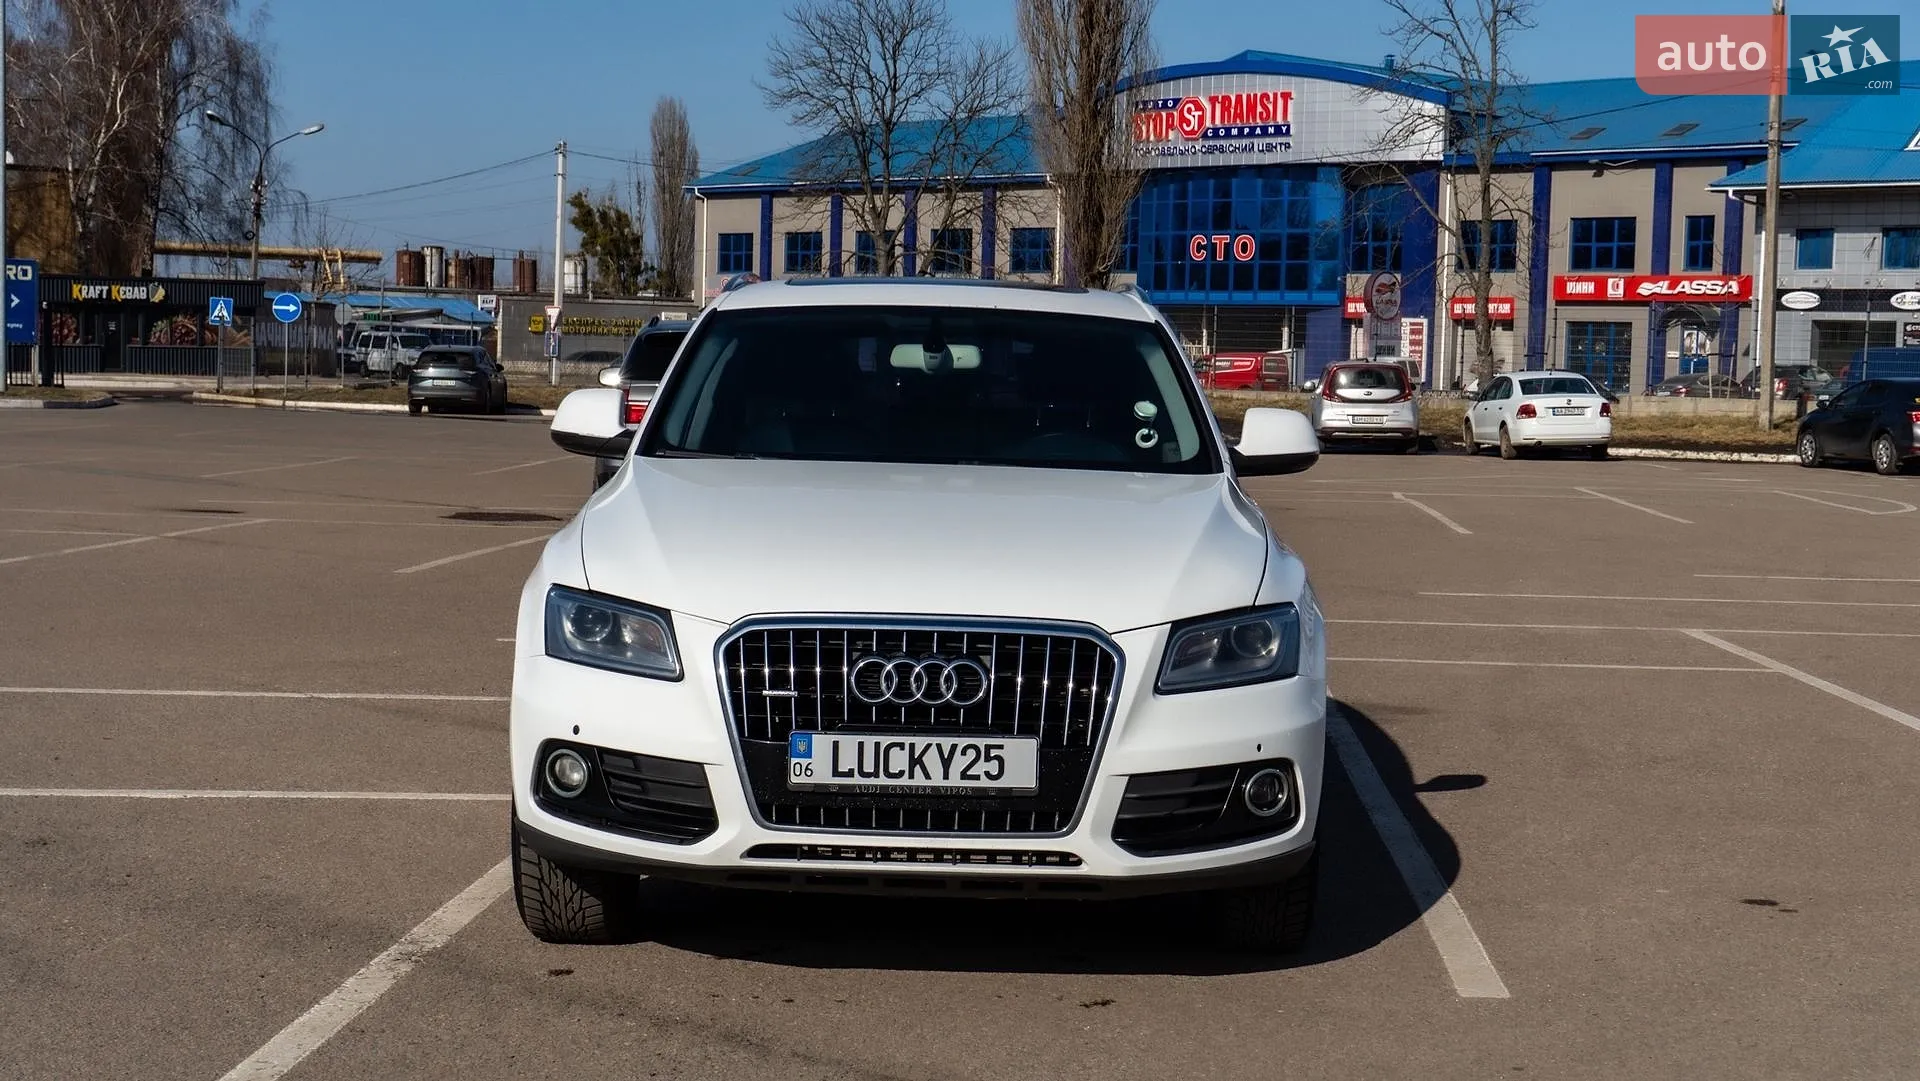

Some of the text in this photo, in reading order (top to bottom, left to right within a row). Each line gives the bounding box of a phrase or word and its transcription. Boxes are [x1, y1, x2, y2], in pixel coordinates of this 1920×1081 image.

[1133, 91, 1293, 142] STOP ST TRANSIT
[1207, 125, 1289, 137] COMPANY
[1257, 142, 1292, 155] ЦЕНТР
[1190, 234, 1256, 261] СТО
[6, 264, 33, 281] RO
[72, 284, 148, 302] KRAFT KEBAB
[1660, 280, 1740, 295] LASSA
[831, 739, 1005, 781] LUCKY25
[792, 761, 814, 778] 06
[854, 785, 973, 795] AUDI CENTER VIPOS
